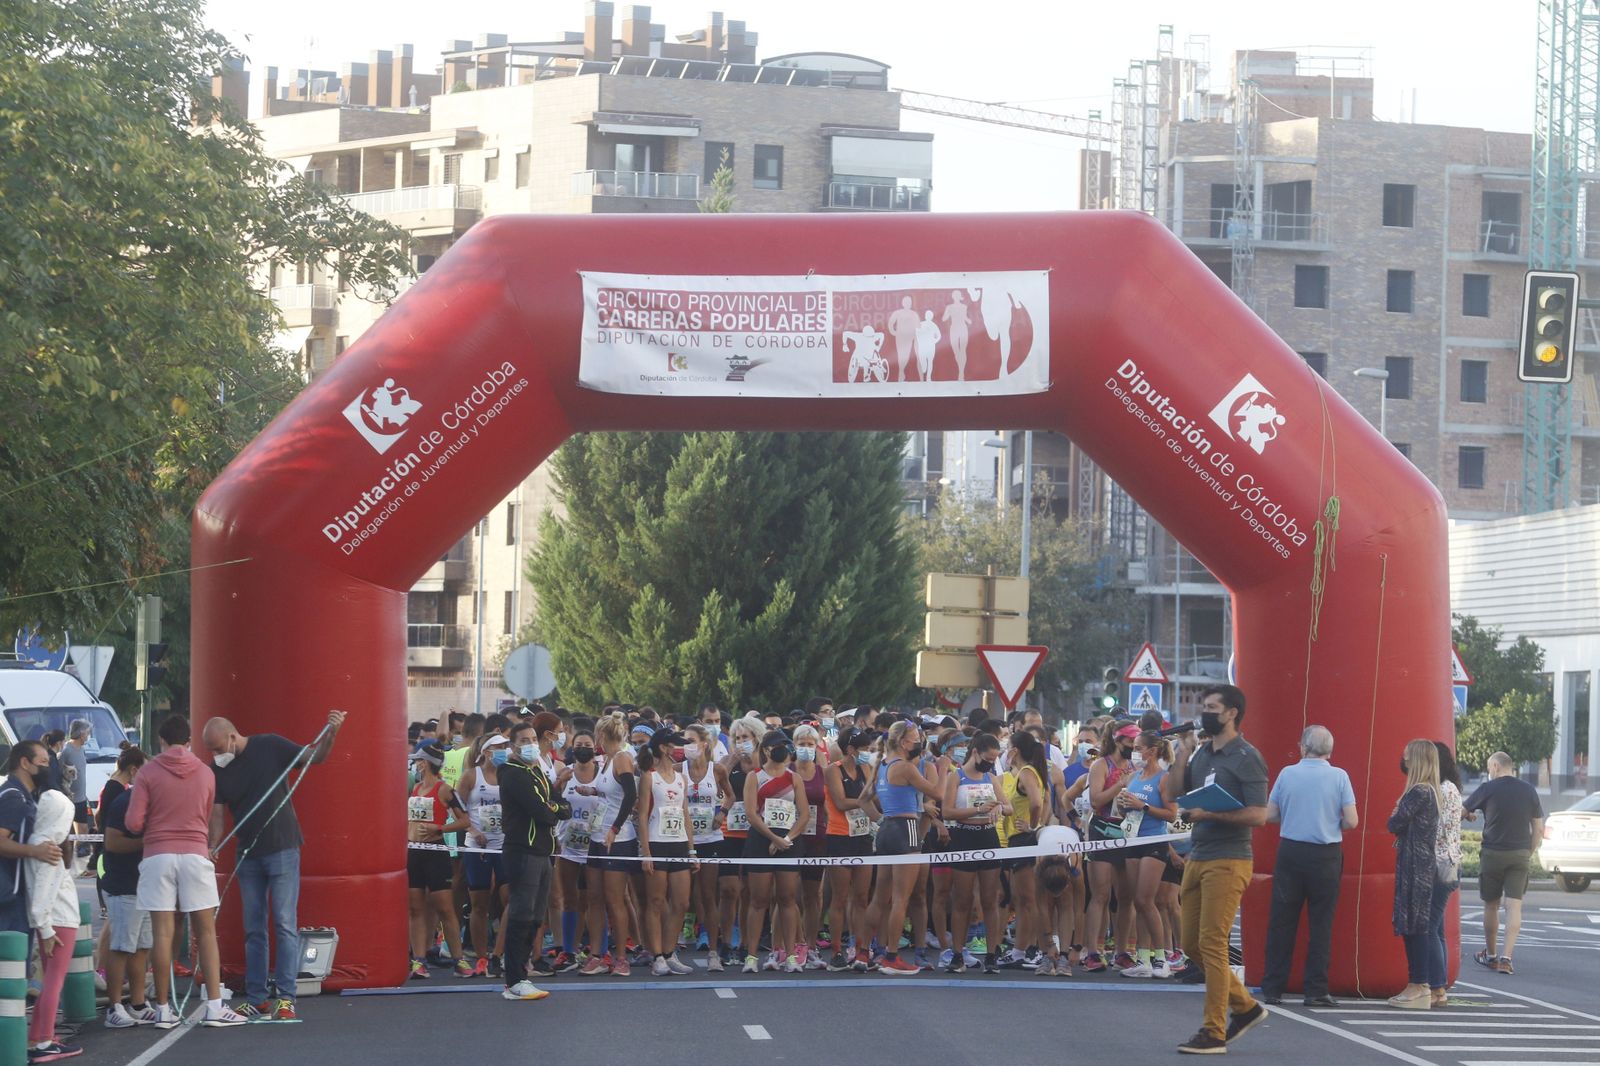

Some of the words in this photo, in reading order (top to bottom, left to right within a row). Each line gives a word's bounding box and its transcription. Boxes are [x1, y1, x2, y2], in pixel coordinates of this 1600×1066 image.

[597, 290, 681, 309] CIRCUITO
[688, 294, 798, 312] PROVINCIAL
[805, 294, 827, 312] DE
[597, 308, 702, 330] CARRERAS
[710, 312, 827, 332] POPULARES
[597, 330, 700, 348] DIPUTACIÓN
[712, 334, 732, 348] DE
[745, 332, 828, 348] CÓRDOBA
[322, 452, 421, 544] Diputación
[418, 430, 444, 456] de
[442, 361, 517, 430] Córdoba
[1117, 358, 1213, 455] Diputación
[1210, 452, 1235, 477] de
[1236, 474, 1308, 547] Córdoba
[341, 496, 404, 556] Delegación
[404, 480, 420, 498] de
[422, 433, 470, 482] Juventud
[469, 424, 480, 438] y
[476, 378, 529, 427] Deportes
[1104, 377, 1166, 440] Delegación
[1166, 438, 1182, 454] de
[1182, 454, 1234, 502] Juventud
[1230, 498, 1242, 512] y
[1240, 508, 1292, 560] Deportes
[771, 812, 790, 822] 307
[570, 834, 590, 844] 240
[930, 850, 996, 862] IMDECO
